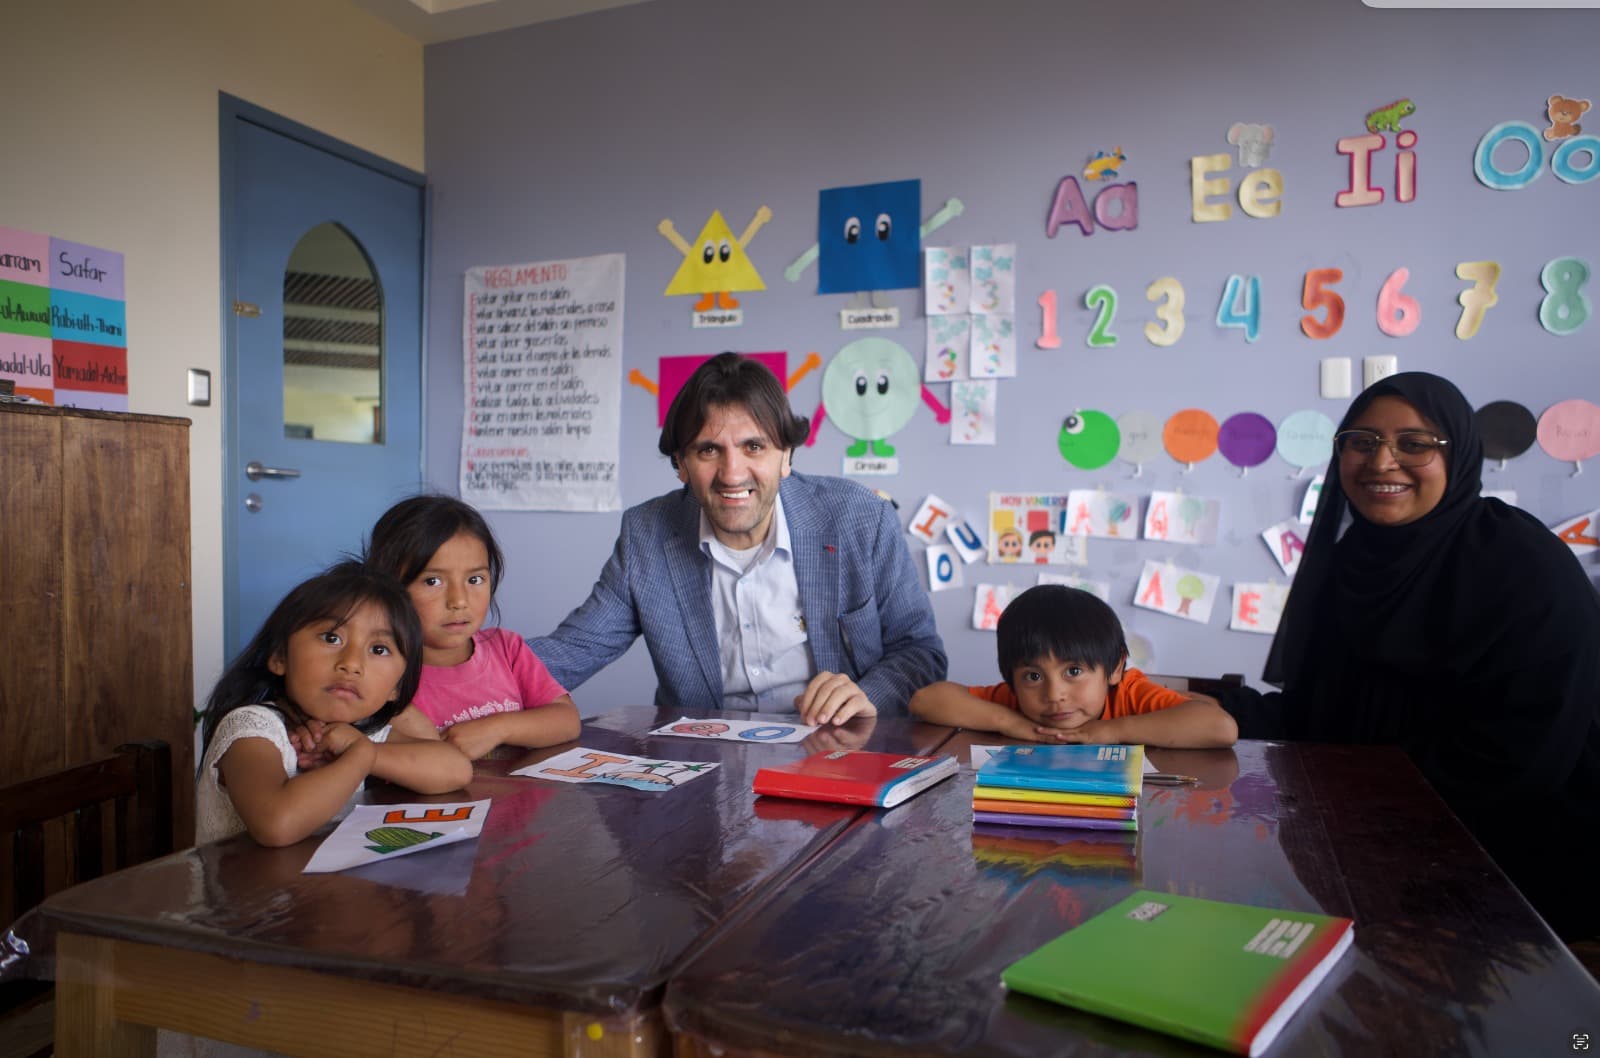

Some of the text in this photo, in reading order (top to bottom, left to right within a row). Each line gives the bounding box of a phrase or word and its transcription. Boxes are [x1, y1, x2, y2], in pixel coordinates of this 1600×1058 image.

[1046, 175, 1137, 239] Aa
[1190, 153, 1284, 223] Ee
[1335, 130, 1417, 208] Ii
[59, 252, 107, 282] Safar
[485, 263, 568, 288] REGLAMENTO
[1037, 256, 1591, 349] 1 2 3 4 5 6 7 8
[848, 313, 893, 324] Cuadrado
[954, 521, 982, 551] U
[1238, 591, 1261, 625] E
